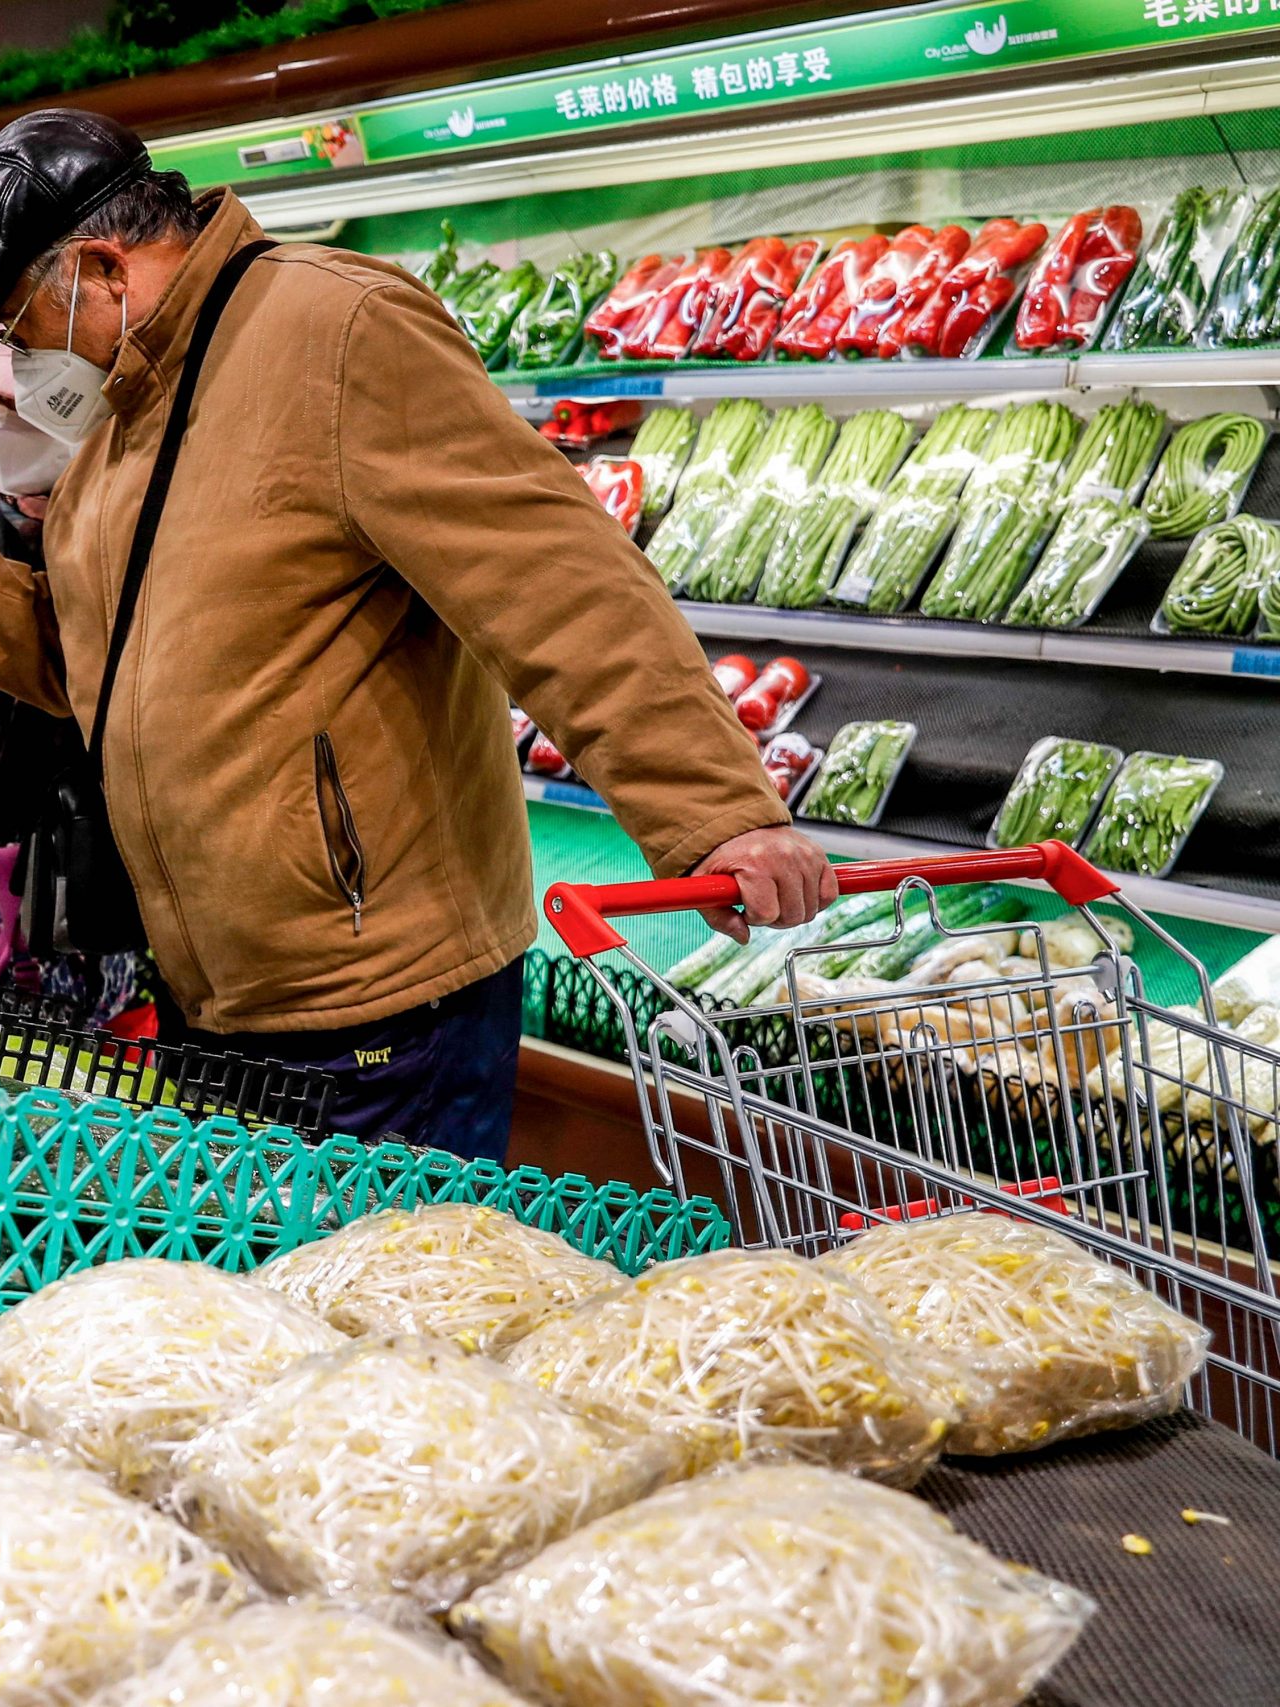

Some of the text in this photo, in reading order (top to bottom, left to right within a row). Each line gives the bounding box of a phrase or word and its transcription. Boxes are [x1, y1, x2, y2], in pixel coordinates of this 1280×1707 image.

[554, 46, 831, 120] 毛菜的价格 精包的享受
[354, 1046, 391, 1067] VOIT
